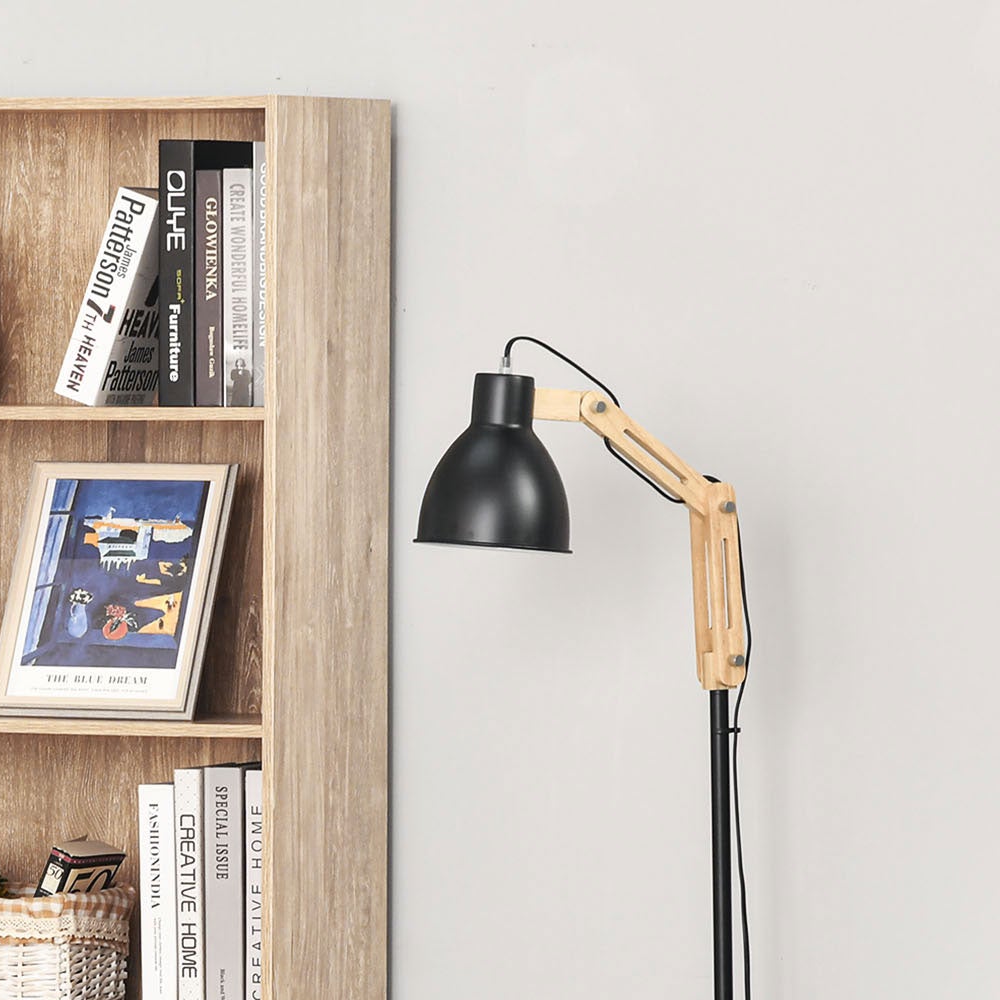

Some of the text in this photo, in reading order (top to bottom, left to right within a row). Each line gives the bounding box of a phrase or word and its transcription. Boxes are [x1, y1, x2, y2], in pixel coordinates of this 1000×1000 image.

[91, 195, 146, 298] Patterson
[117, 244, 137, 279] James
[204, 197, 218, 300] GLOWIENKA
[229, 183, 249, 351] CREATE WONDERFUL HOMELIFE
[82, 313, 97, 331] TH
[119, 308, 159, 338] HEAV
[124, 341, 155, 363] James
[168, 304, 181, 382] Furniture
[66, 335, 96, 392] HEAVEN
[102, 361, 159, 391] Patterson
[46, 674, 68, 683] THE
[109, 676, 147, 685] DREAM
[215, 786, 229, 880] SPECIAL ISSUE
[251, 805, 262, 869] HOME
[179, 814, 197, 978] CREATIVE HOME
